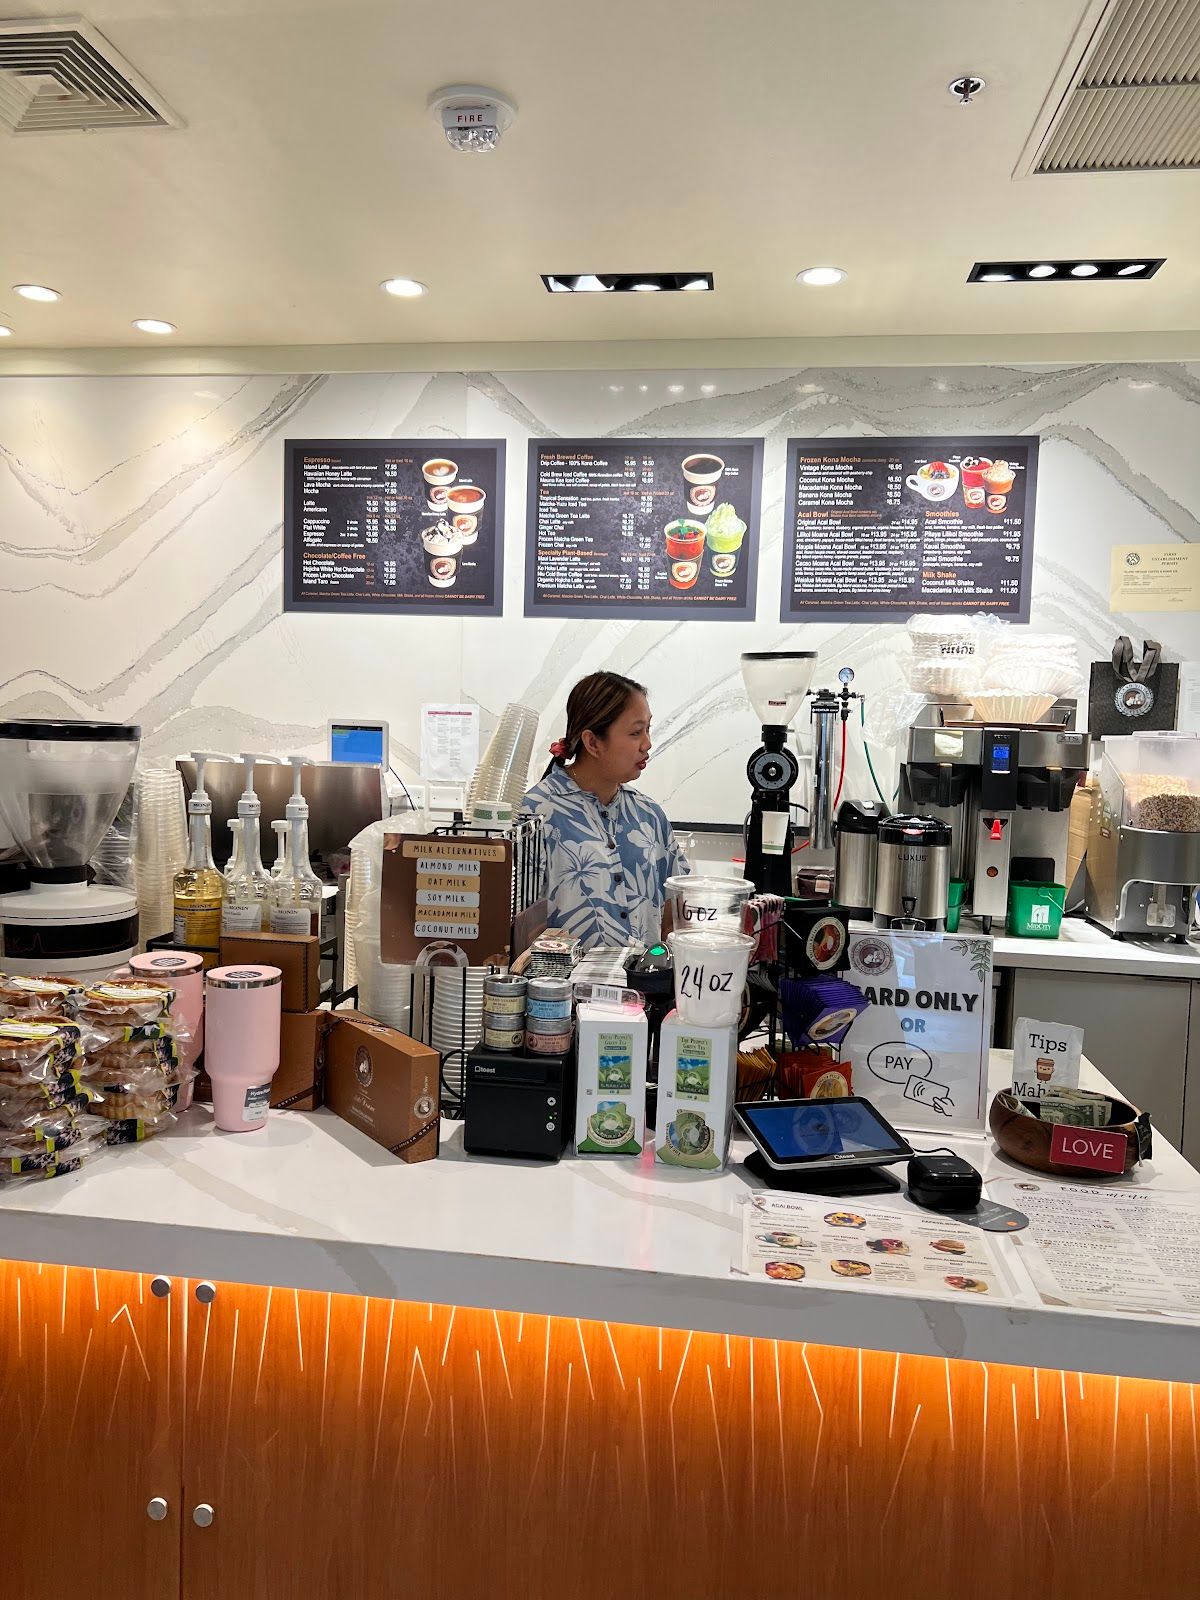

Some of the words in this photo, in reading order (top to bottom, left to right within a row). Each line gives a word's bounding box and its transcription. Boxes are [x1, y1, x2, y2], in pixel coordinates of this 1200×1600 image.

[436, 847, 496, 856] ALTERNATIVES
[420, 862, 452, 870] ALMOND
[458, 863, 478, 871] MILK
[416, 924, 453, 933] COCONUT
[681, 965, 704, 1000] 24
[865, 987, 909, 1007] ARD
[916, 990, 978, 1012] ONLY
[901, 1017, 926, 1033] OR
[1029, 1034, 1067, 1053] Tips
[885, 1055, 914, 1070] PAY
[1013, 1082, 1046, 1098] Mah
[1062, 1138, 1114, 1159] LOVE
